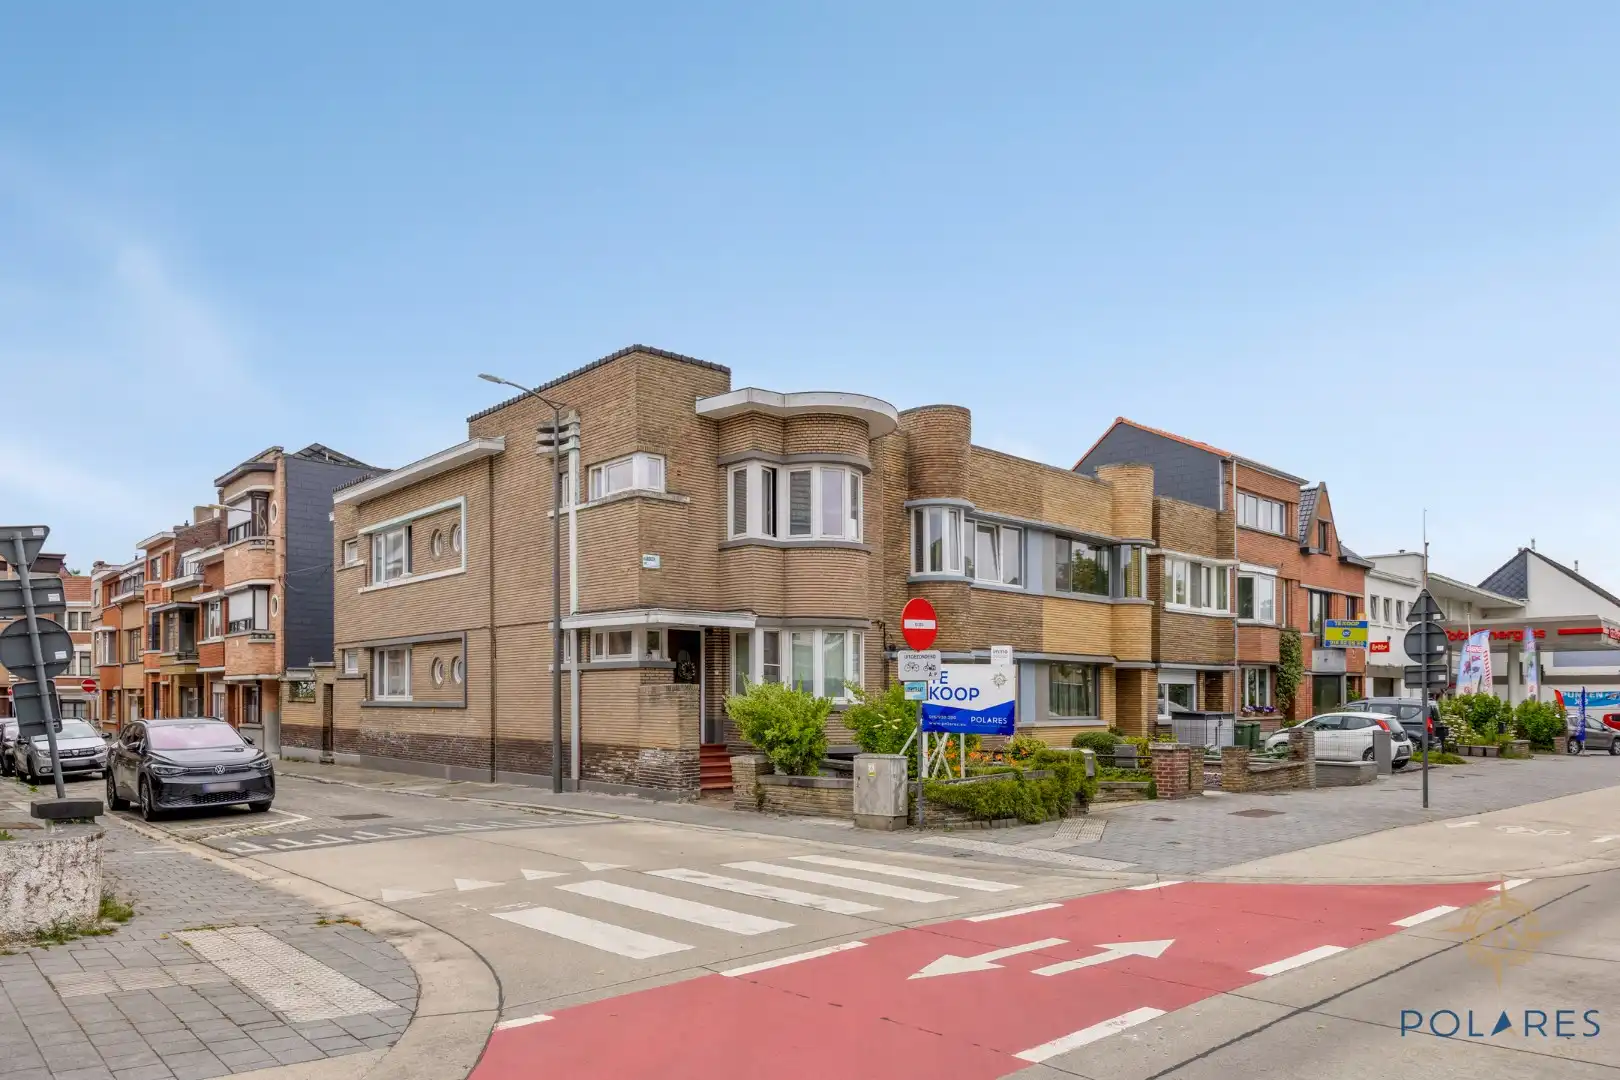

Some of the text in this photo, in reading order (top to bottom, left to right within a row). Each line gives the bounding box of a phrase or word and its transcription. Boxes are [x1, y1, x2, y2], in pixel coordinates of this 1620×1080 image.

[1444, 627, 1546, 642] otanerges
[932, 671, 948, 684] E
[929, 686, 980, 701] KOOP
[970, 716, 1008, 725] POLARES
